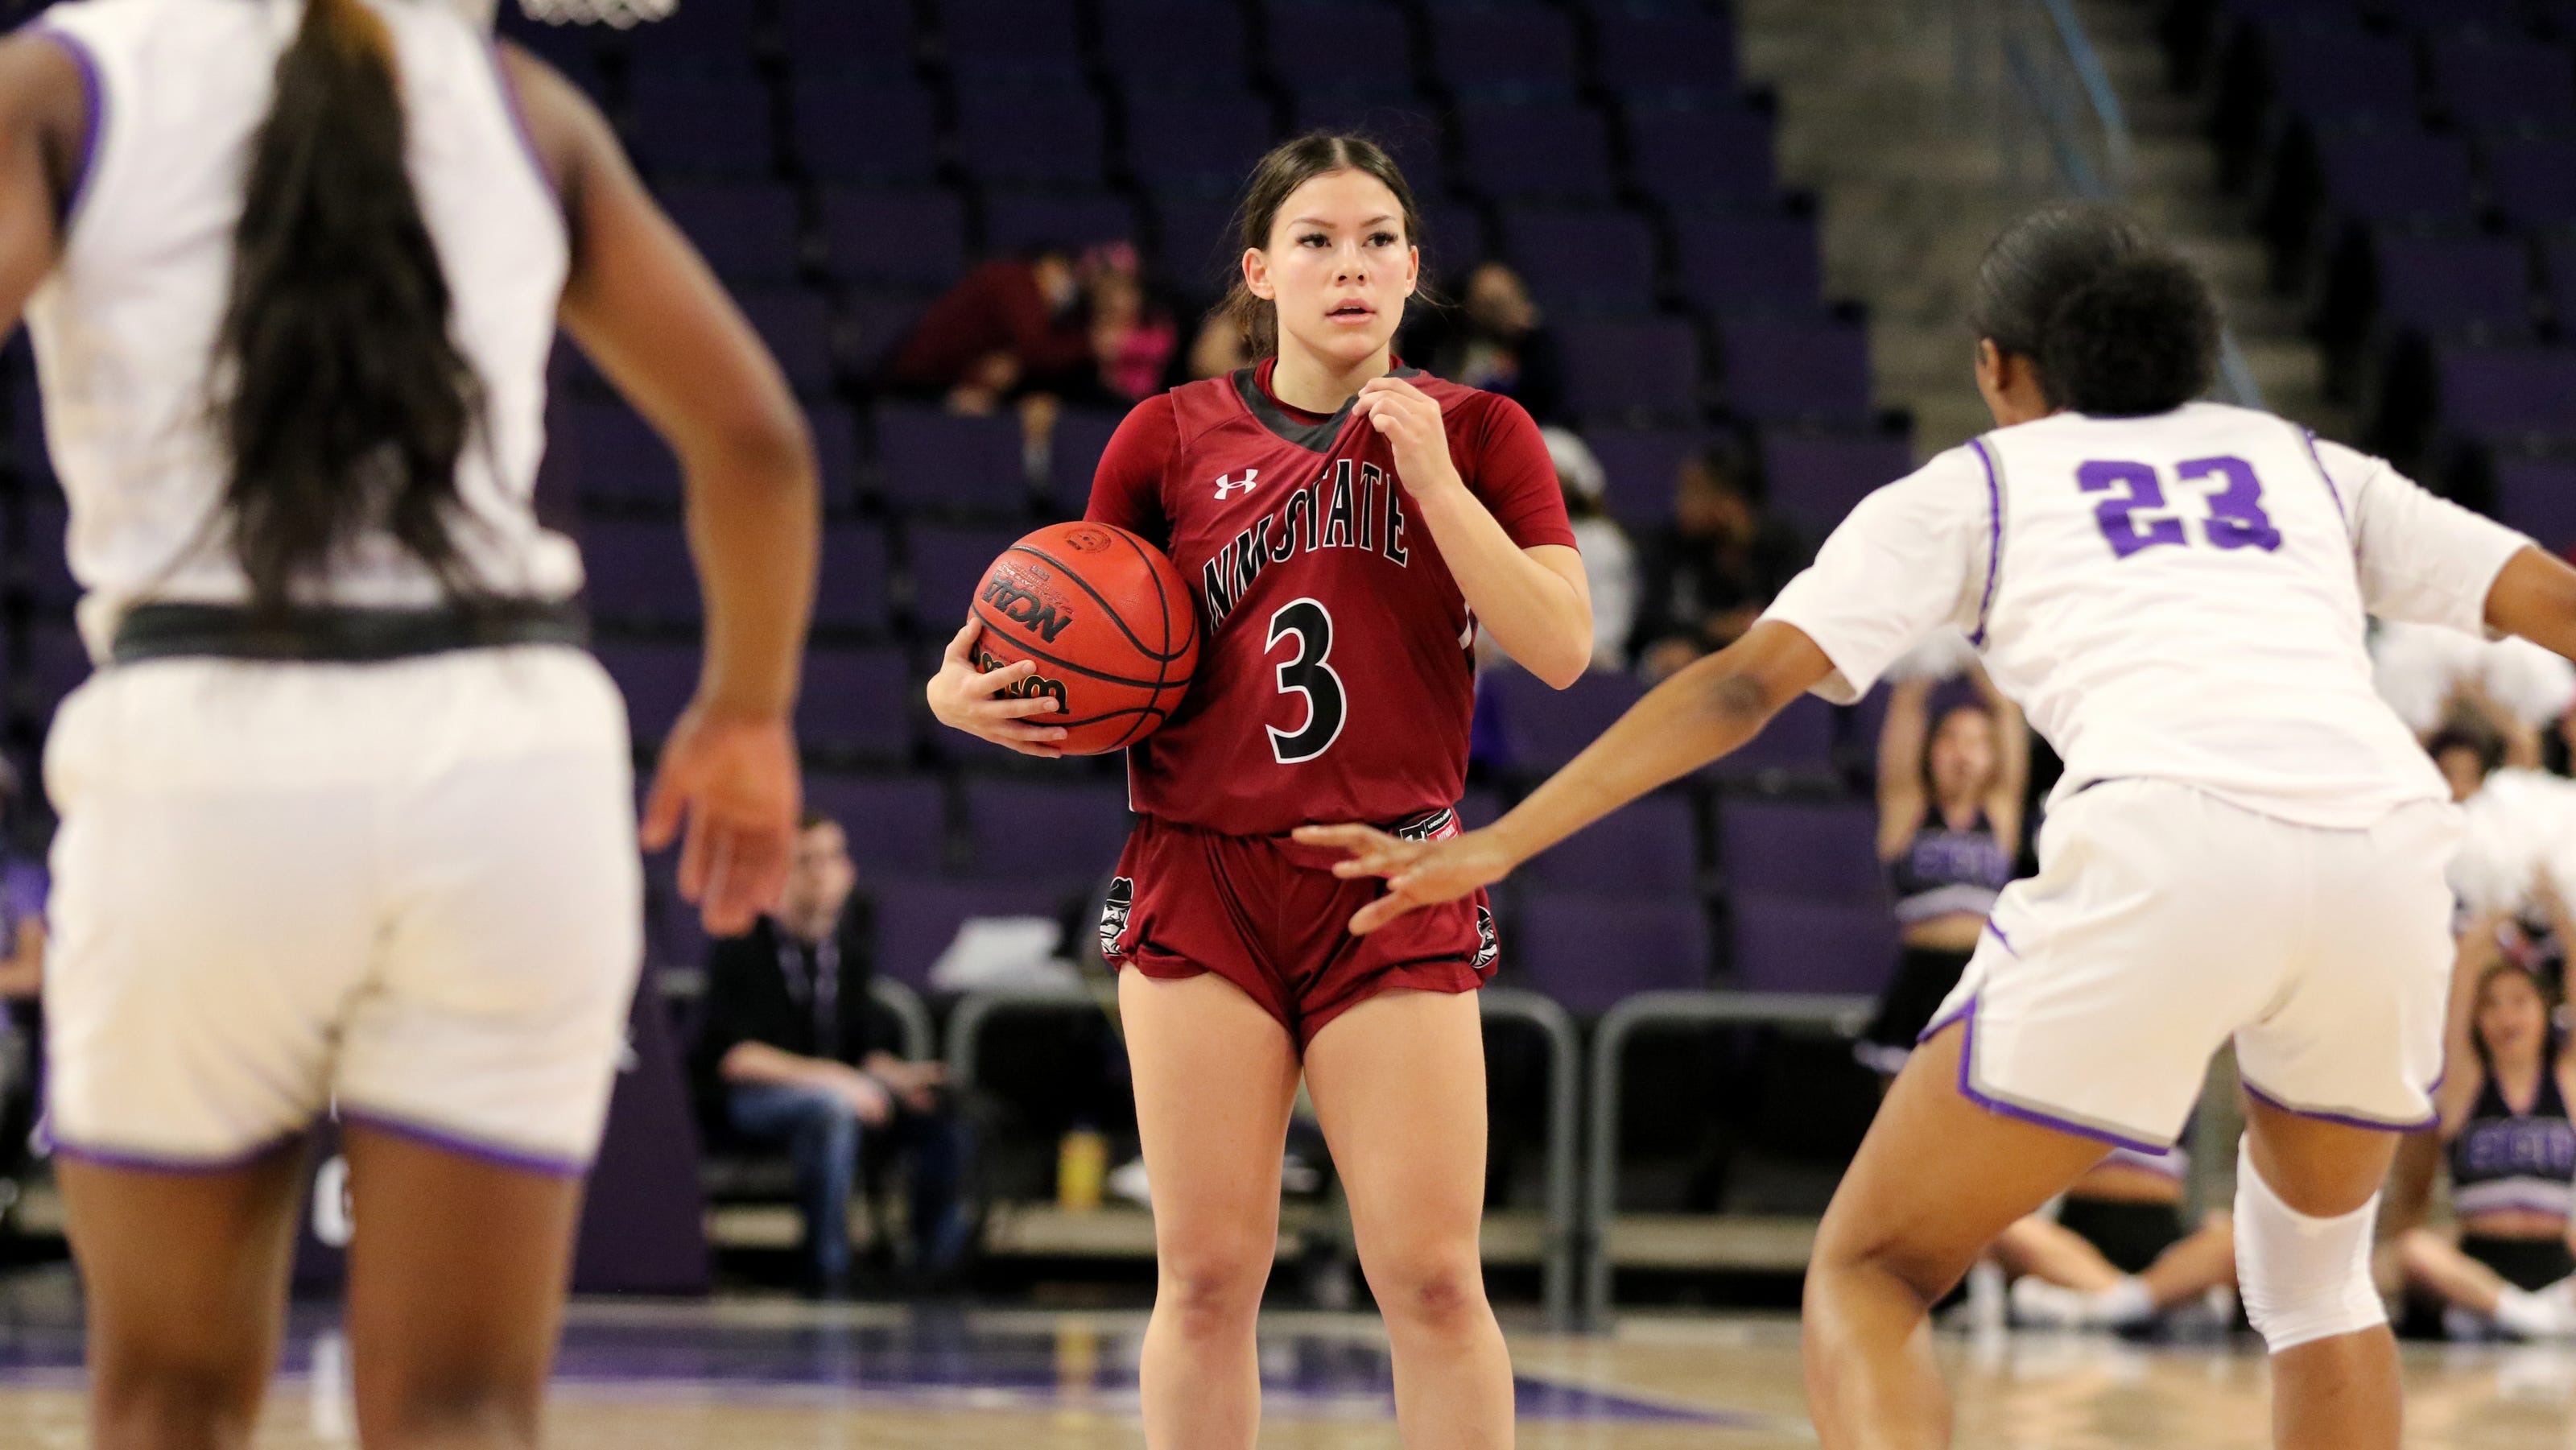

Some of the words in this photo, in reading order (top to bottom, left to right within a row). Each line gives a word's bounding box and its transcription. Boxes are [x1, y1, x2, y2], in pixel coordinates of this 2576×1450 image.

[2074, 455, 2281, 559] 23
[981, 570, 1073, 644] NCAA
[1264, 597, 1348, 764] 3
